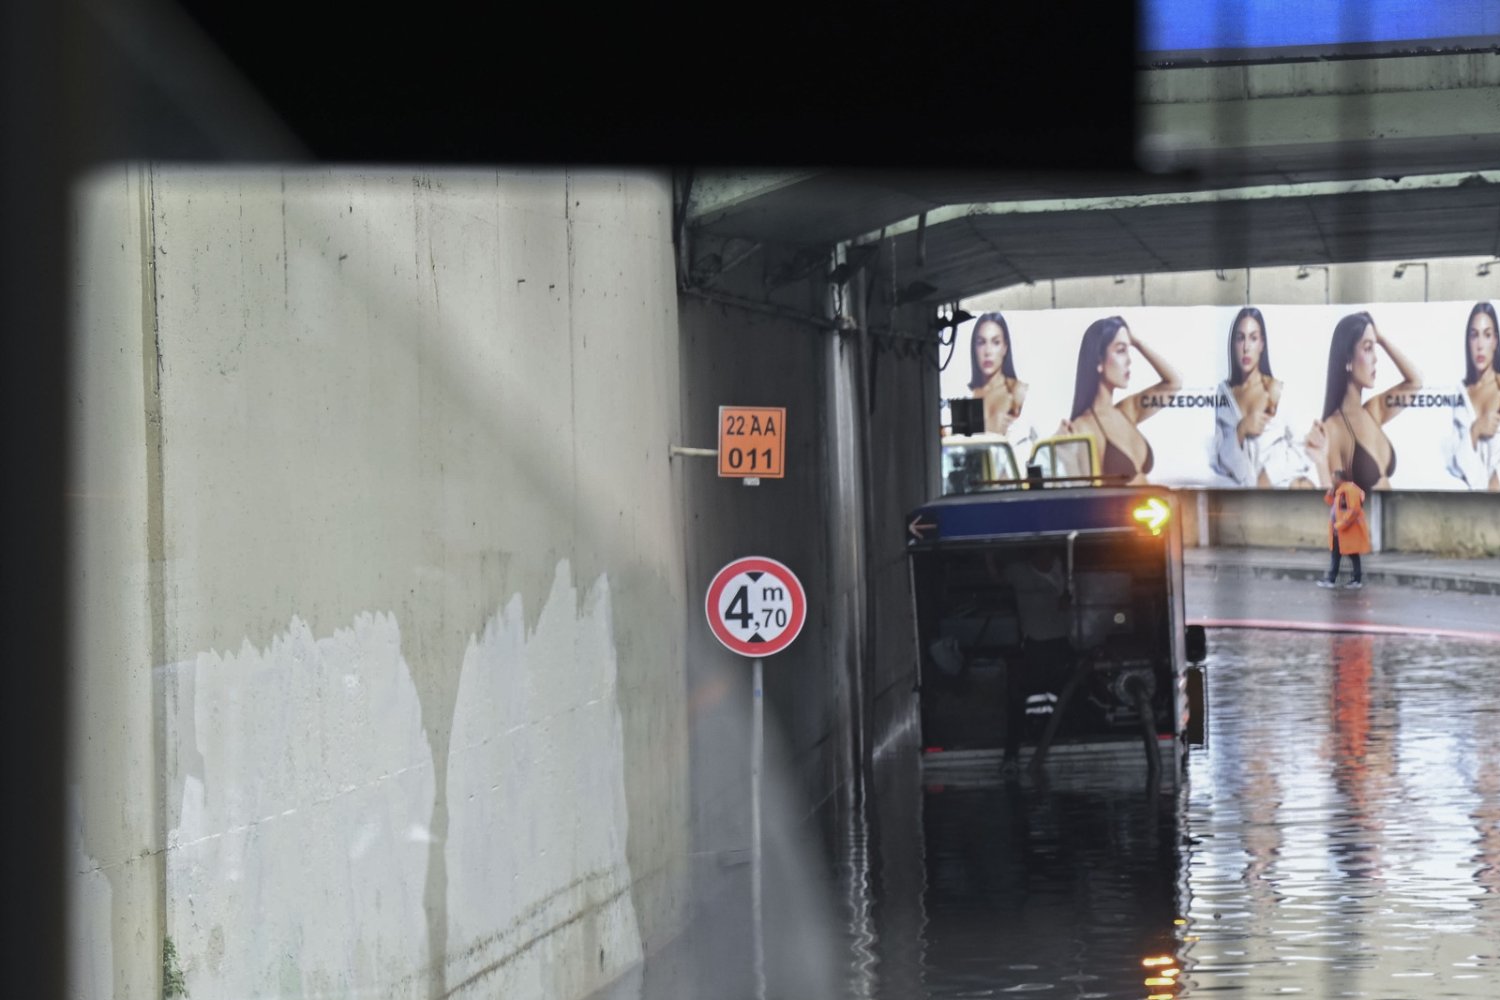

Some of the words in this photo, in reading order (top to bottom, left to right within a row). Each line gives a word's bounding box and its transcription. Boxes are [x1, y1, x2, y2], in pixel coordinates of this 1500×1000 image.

[1140, 394, 1230, 408] CALZEDONIA
[1385, 393, 1465, 407] CALZEDONIA
[726, 416, 745, 436] 22
[750, 415, 776, 436] AA
[728, 447, 772, 470] 011
